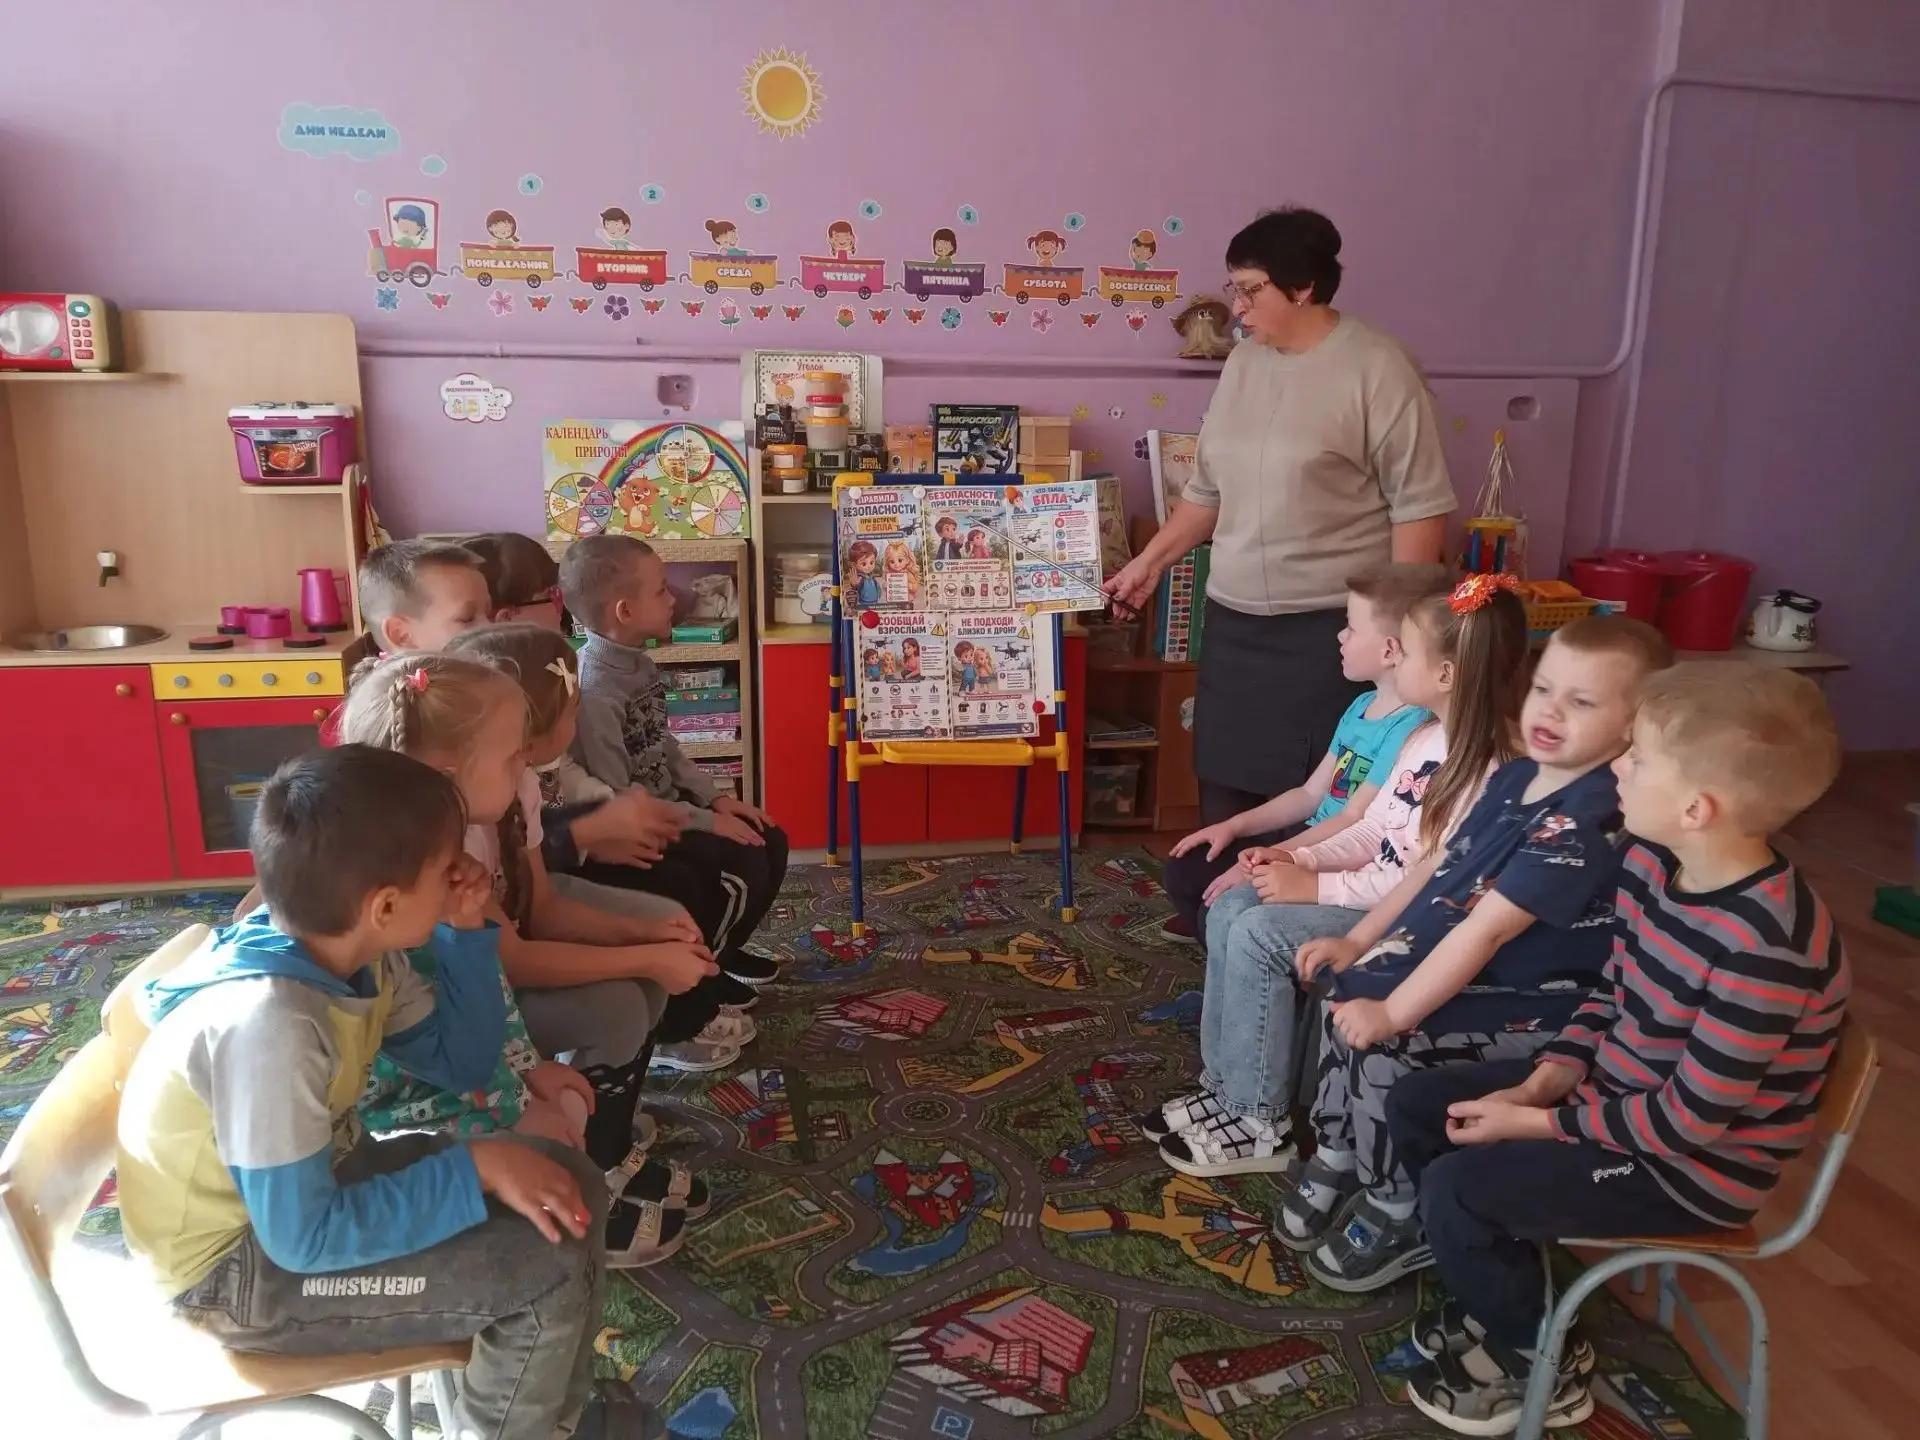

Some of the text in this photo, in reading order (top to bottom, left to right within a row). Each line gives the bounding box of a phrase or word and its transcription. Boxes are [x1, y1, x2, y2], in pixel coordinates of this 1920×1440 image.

[295, 124, 386, 139] ДНИ НЕДЕЛИ
[527, 180, 534, 189] 1
[648, 190, 656, 199] 2
[755, 198, 762, 207] 3
[866, 206, 873, 214] 4
[965, 211, 972, 220] 5
[1070, 217, 1077, 226] 6
[1171, 221, 1178, 231] 7
[466, 258, 549, 271] ПОНЕДЕЛЬНИК
[597, 263, 649, 275] ВТОРНИК
[717, 268, 753, 278] СРЕДА
[823, 271, 867, 282] ЧЕТВЕРГ
[922, 276, 970, 286] ПЯТНИЦА
[1023, 279, 1067, 290] СУББОТА
[1109, 281, 1172, 293] ВОСКРЕСЕНЬЕ
[797, 362, 825, 371] Уголок
[939, 416, 1002, 424] МИКРОСКОП
[546, 427, 609, 440] КАЛЕНДАРЬ
[575, 446, 628, 458] ПРИРОДЫ
[1173, 454, 1196, 464] ОКТ
[858, 494, 896, 504] ПРАВИЛА
[930, 499, 1001, 508] ПРИ ВСТРЕЧЕ БПЛА
[1033, 494, 1068, 506] БПЛА
[843, 503, 917, 518] БЕЗОПАСНОСТИ
[873, 516, 897, 524] ВСТРЕЧЕ
[872, 524, 893, 532] БПЛА
[879, 614, 925, 626] СООБЩАЙ
[961, 616, 1014, 627] НЕ ПОДХОДИ
[878, 626, 927, 635] ВЗРОСЛЫМ
[957, 627, 986, 636] БЛИЗКО
[993, 626, 1017, 635] ДРОНУ
[302, 1276, 382, 1297] FASHION
